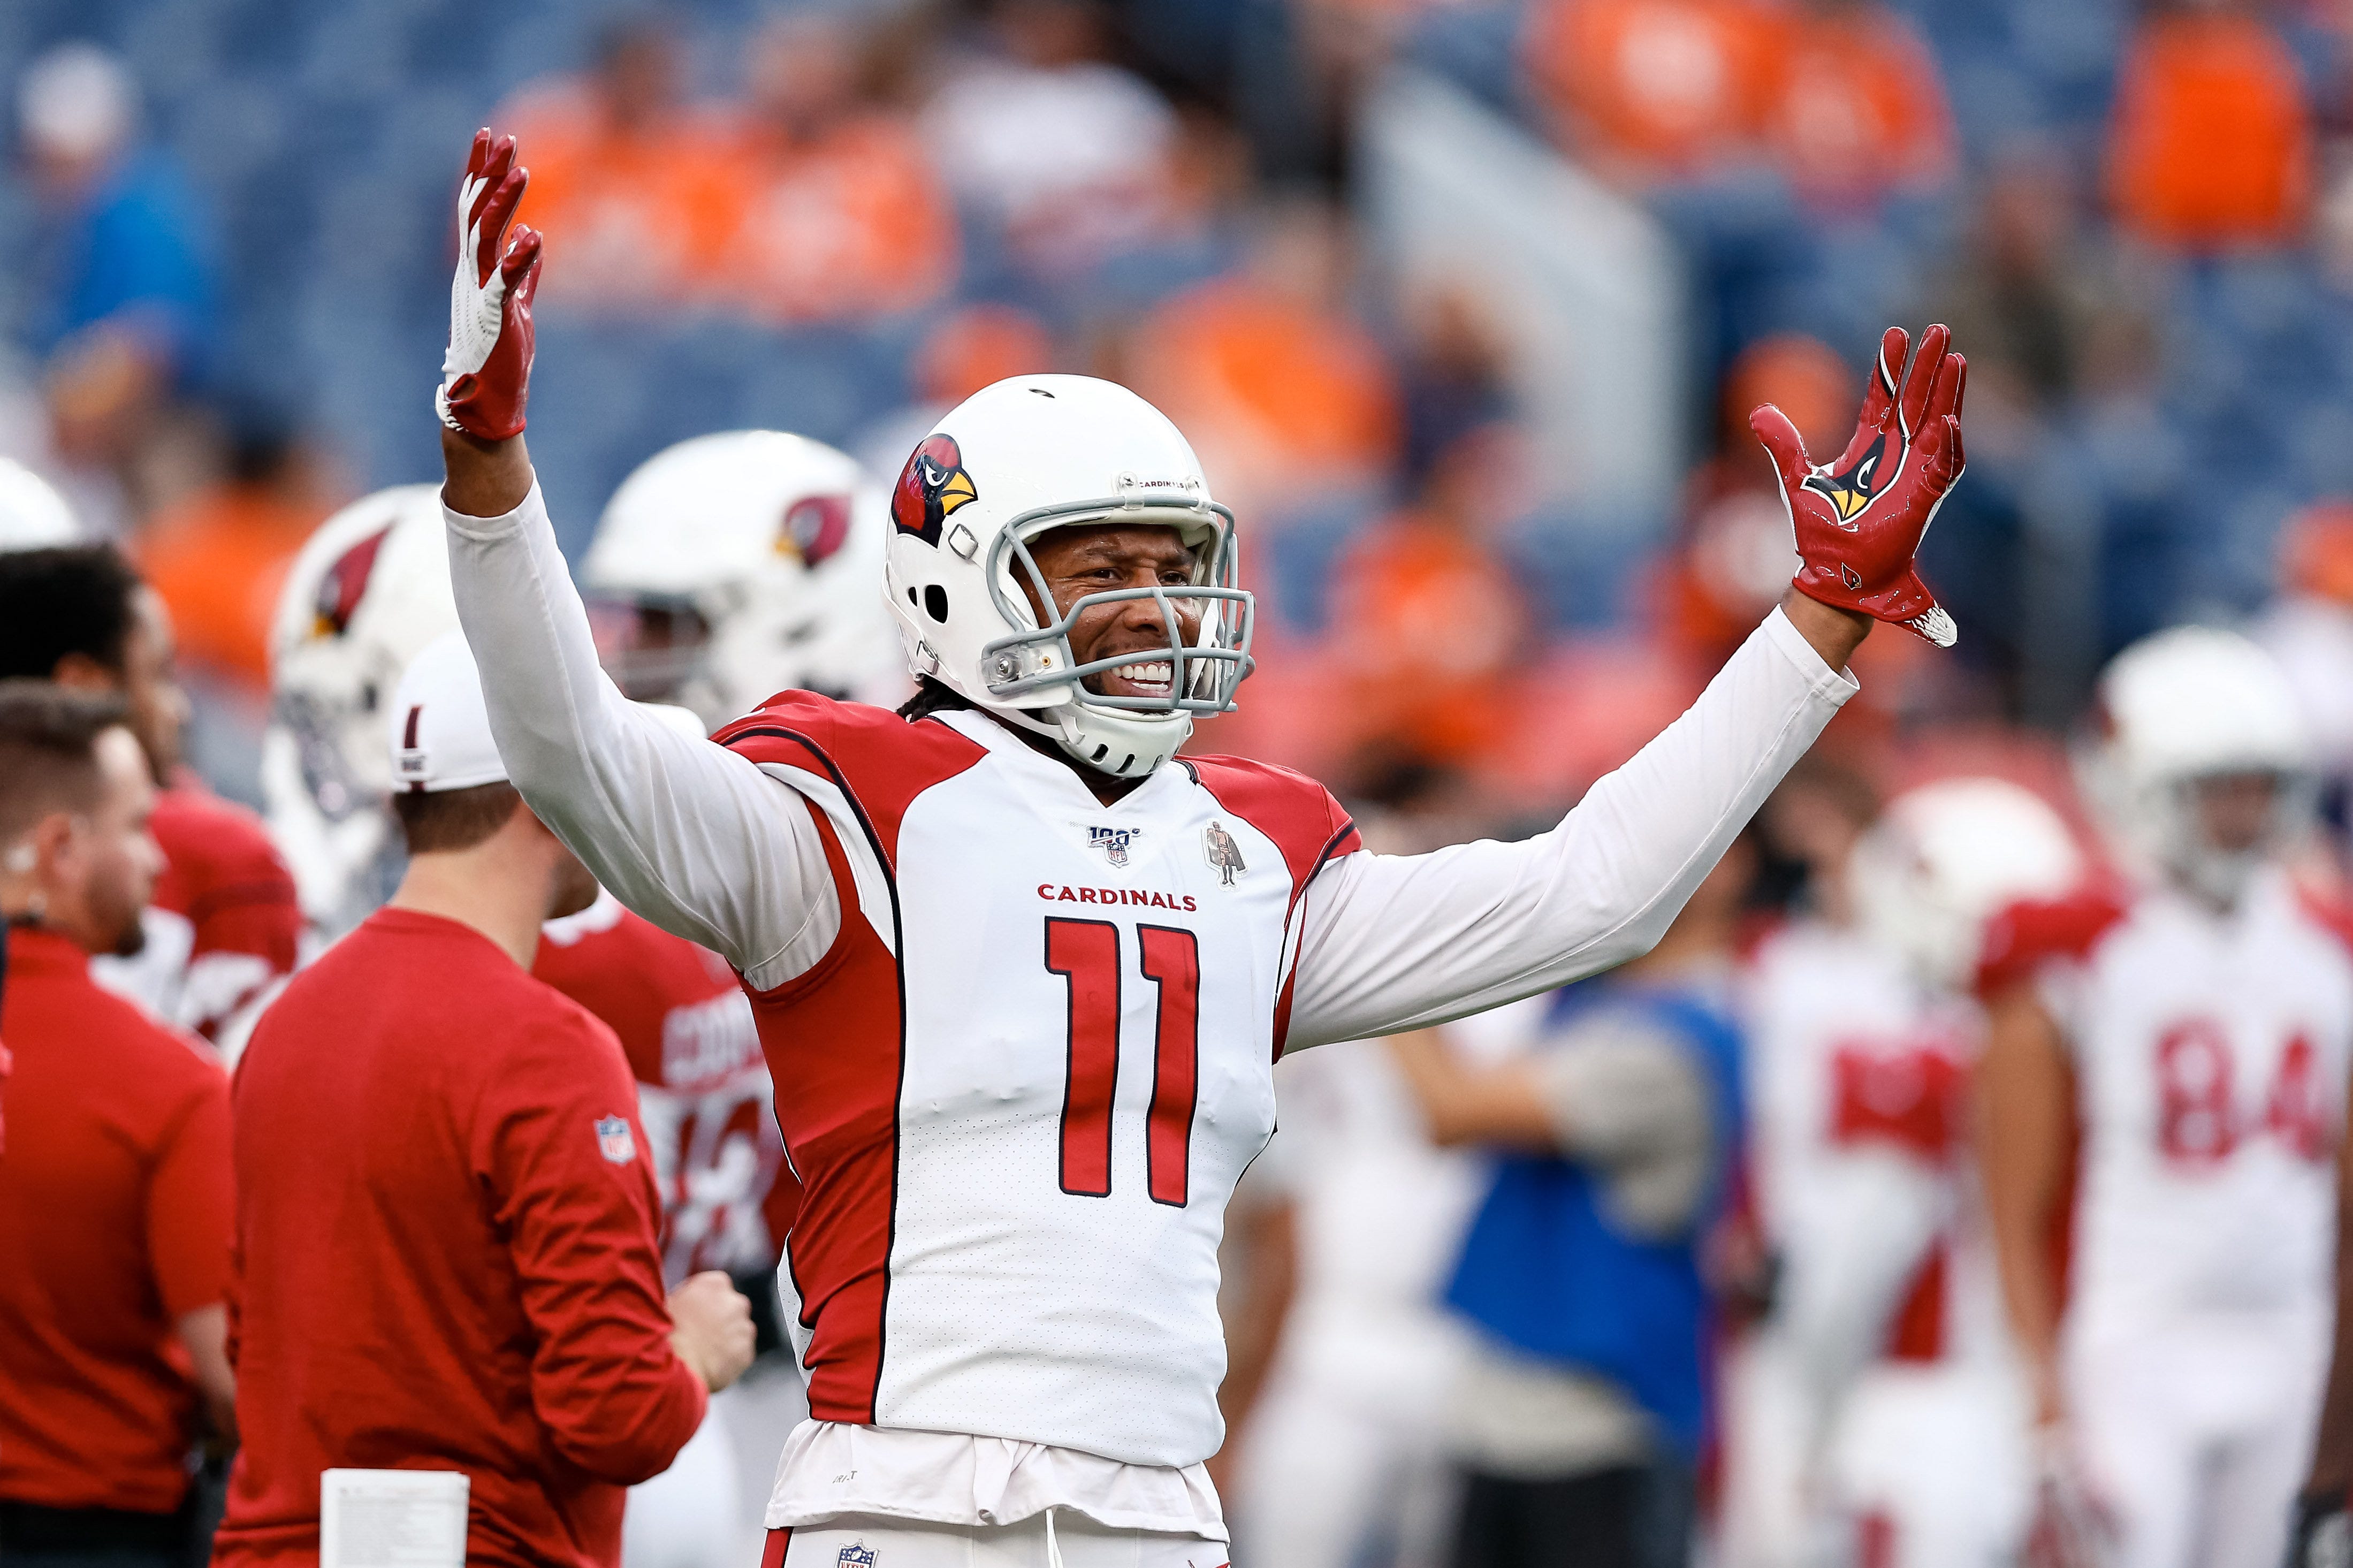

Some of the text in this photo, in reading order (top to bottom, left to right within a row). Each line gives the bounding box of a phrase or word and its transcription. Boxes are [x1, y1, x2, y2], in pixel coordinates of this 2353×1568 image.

[1037, 884, 1197, 912] CARDINALS
[1109, 850, 1126, 861] NFL
[1044, 915, 1200, 1209] 11
[2152, 1017, 2331, 1172] 84
